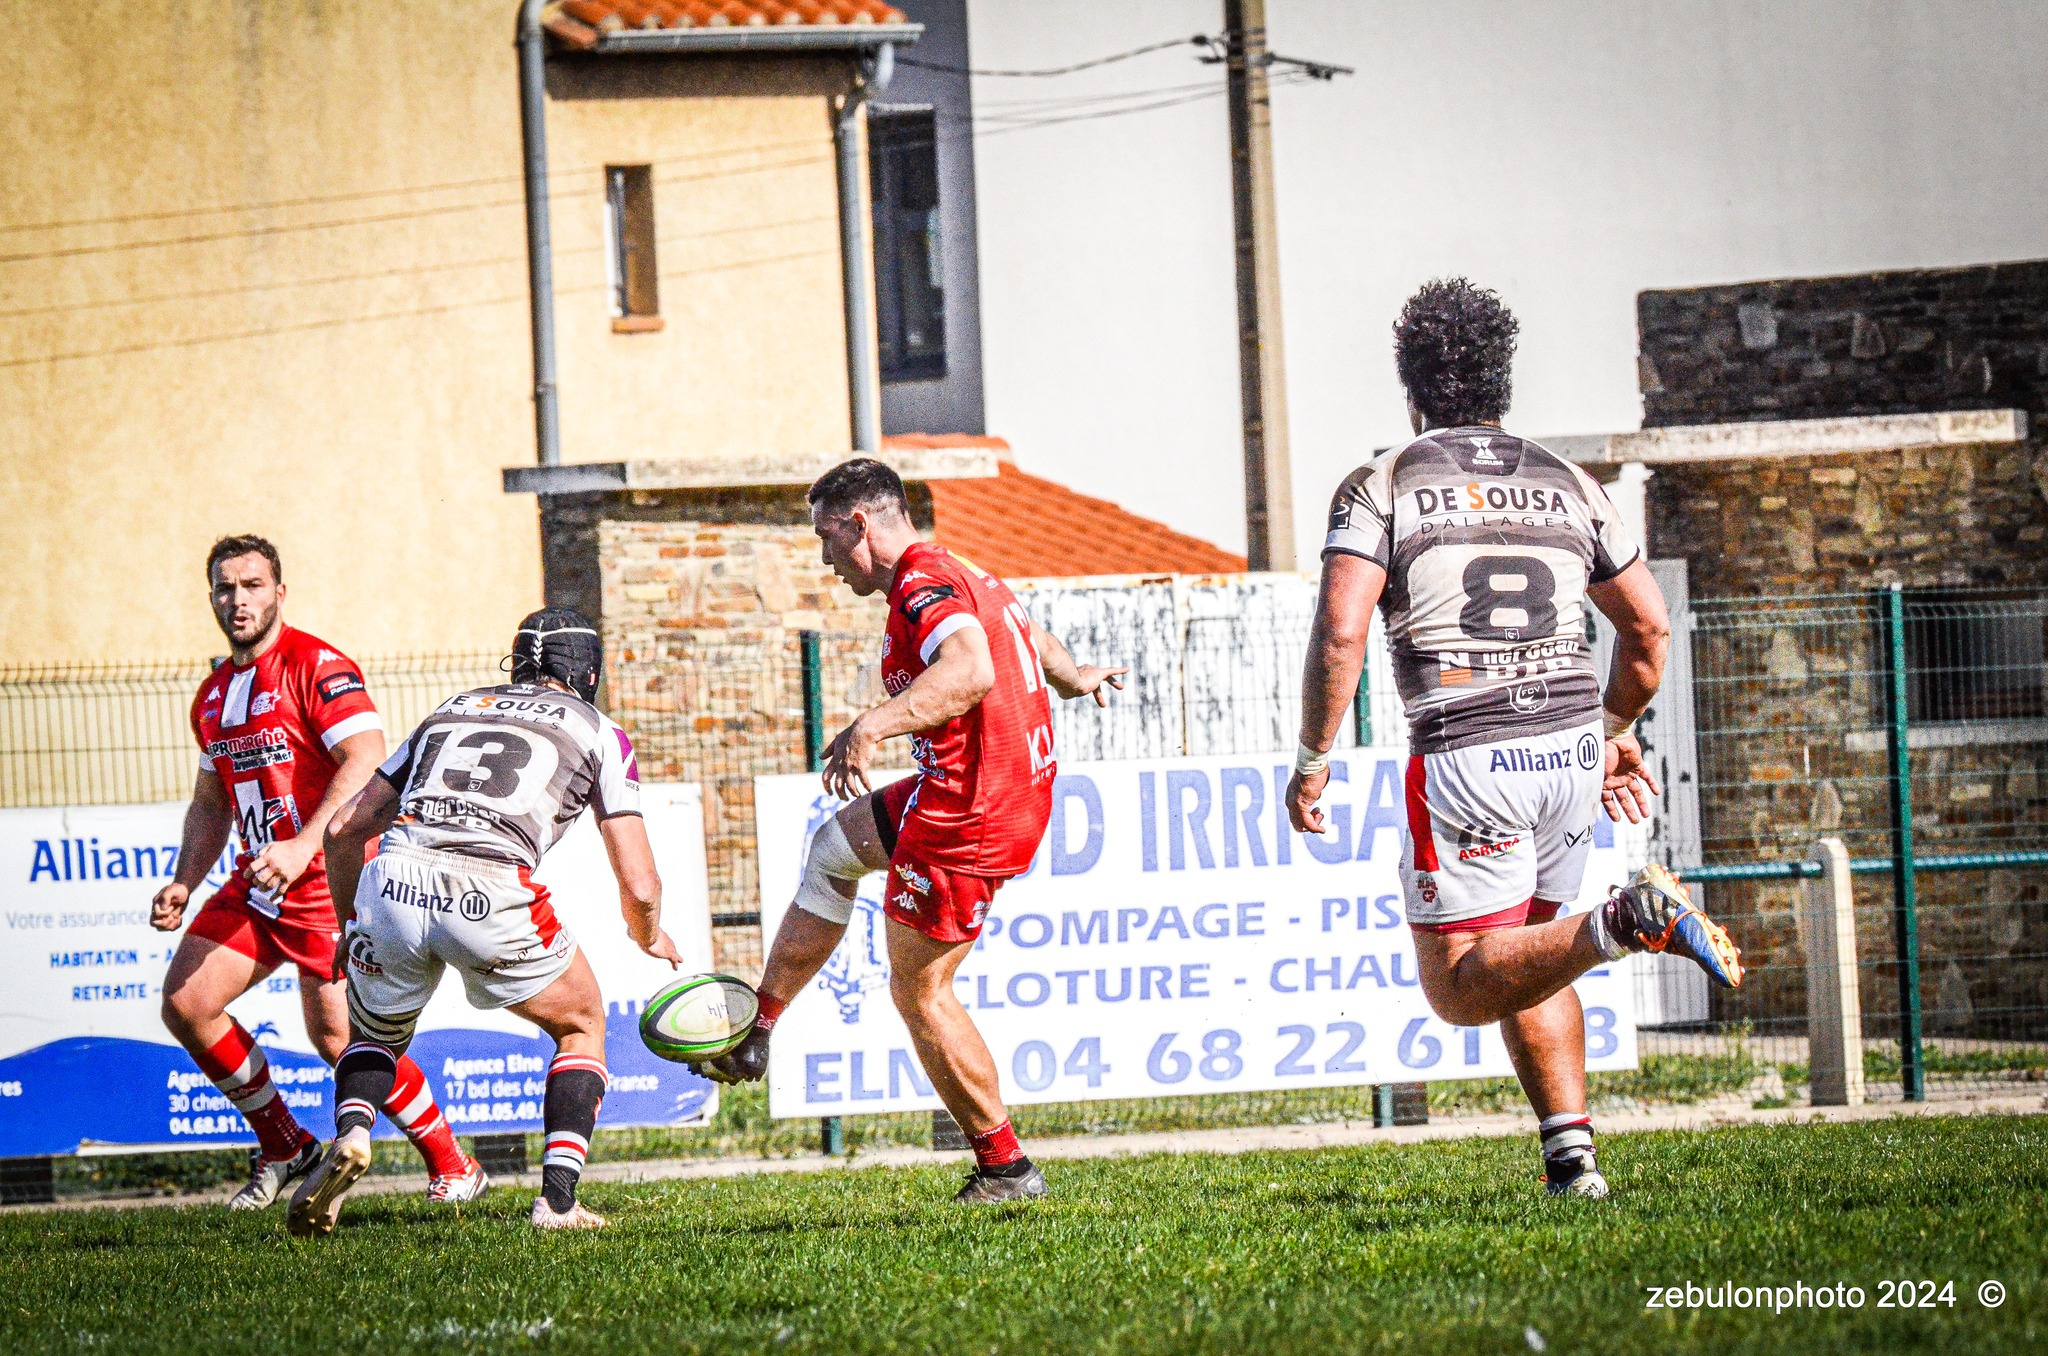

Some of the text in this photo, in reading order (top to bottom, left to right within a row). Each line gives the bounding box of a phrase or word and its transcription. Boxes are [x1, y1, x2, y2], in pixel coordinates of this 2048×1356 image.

[1414, 482, 1568, 516] DE SOUSA
[1421, 516, 1573, 534] DALLAGES
[1459, 556, 1556, 640] 8
[1486, 657, 1572, 680] BTP
[434, 708, 560, 730] ALLAGES
[476, 696, 567, 720] SOUSA
[411, 730, 532, 798] 13
[1490, 749, 1572, 772] Allianz
[29, 838, 181, 882] Allianz
[381, 877, 453, 914] Allianz
[6, 911, 52, 930] Votre
[973, 902, 1265, 952] POMPAGE
[50, 950, 138, 968] HABITATION
[72, 983, 147, 1001] RETRAITE
[442, 1053, 544, 1080] Agence Elne
[805, 1047, 935, 1103] ELN
[1012, 1037, 1110, 1092] 04
[1147, 1029, 1243, 1085] 68
[1275, 1021, 1366, 1076] 22
[445, 1081, 465, 1099] 17
[467, 1079, 490, 1099] bd
[491, 1078, 521, 1098] des
[169, 1094, 189, 1112] 30
[444, 1101, 544, 1123] 04.68.05.49.
